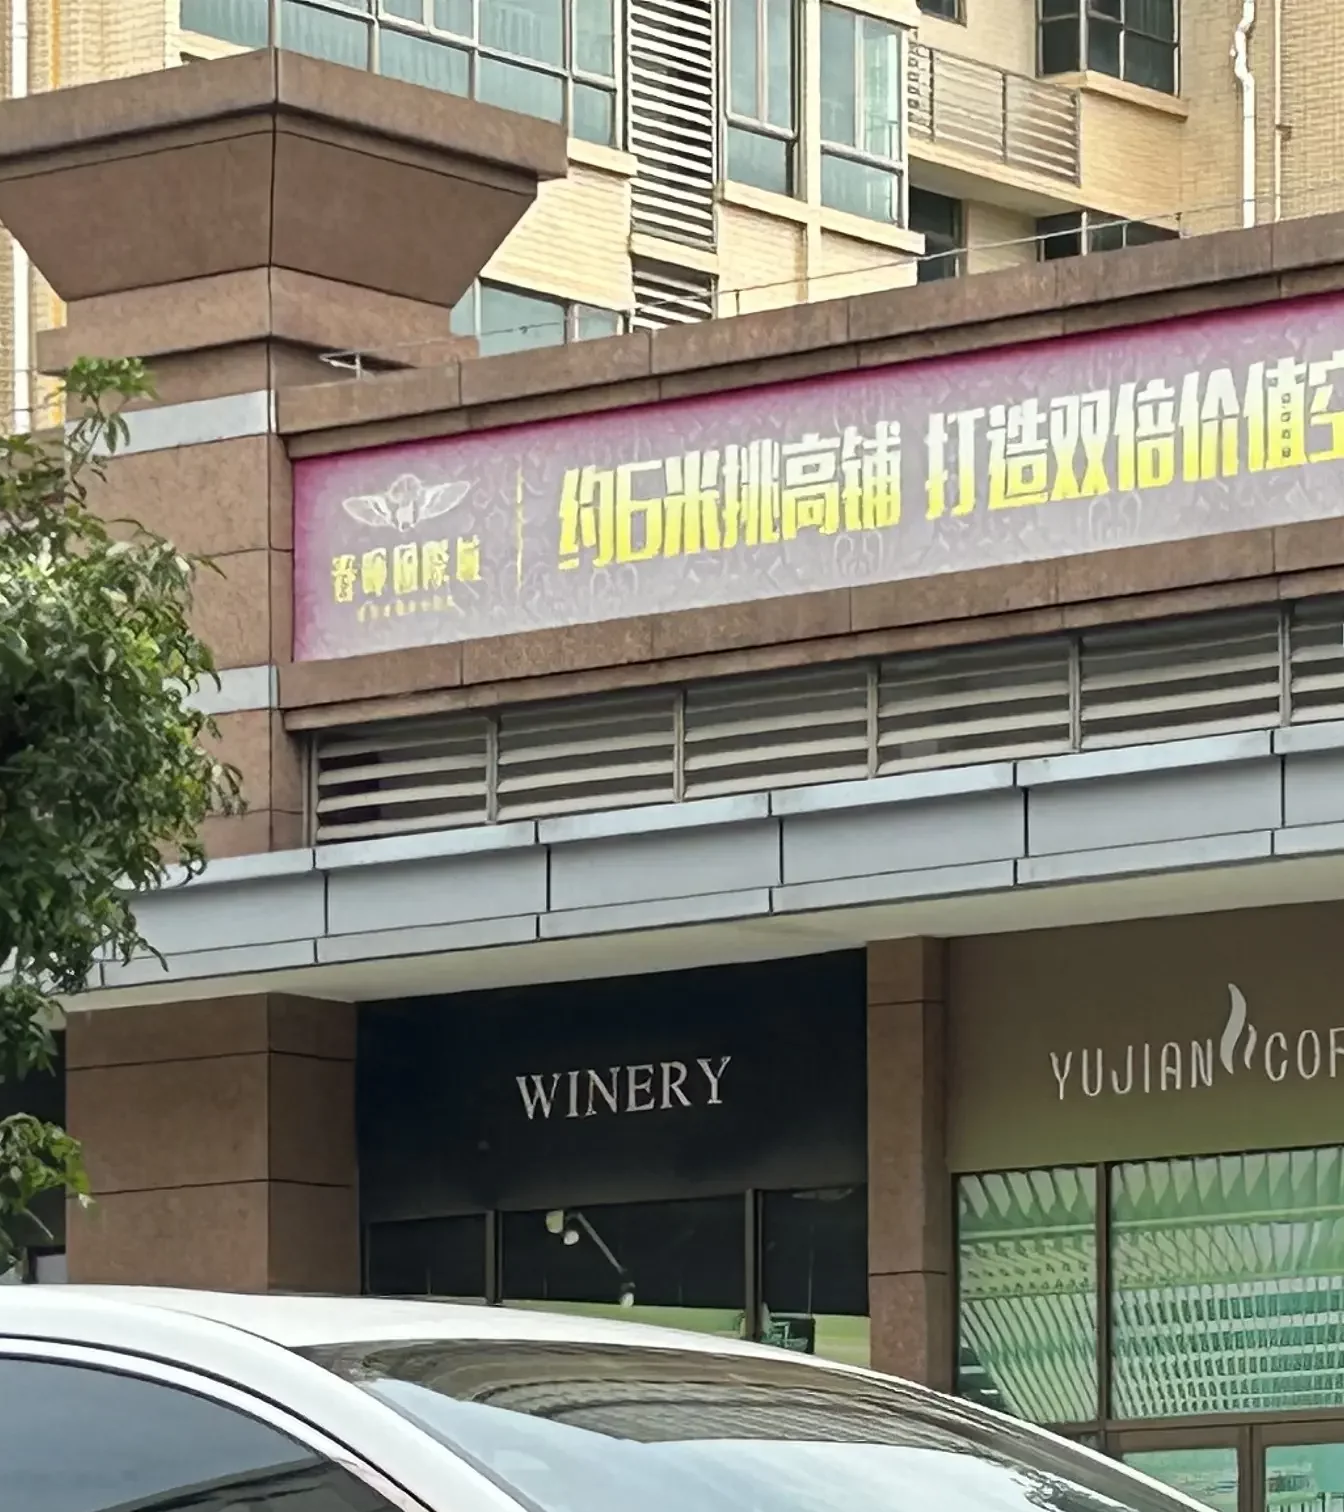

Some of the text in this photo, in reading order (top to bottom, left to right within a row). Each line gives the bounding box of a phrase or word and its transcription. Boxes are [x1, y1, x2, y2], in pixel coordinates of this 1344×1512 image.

[558, 420, 901, 570] 约6米挑高铺
[515, 1055, 732, 1120] WINERY
[1049, 1038, 1213, 1100] YUJIAN
